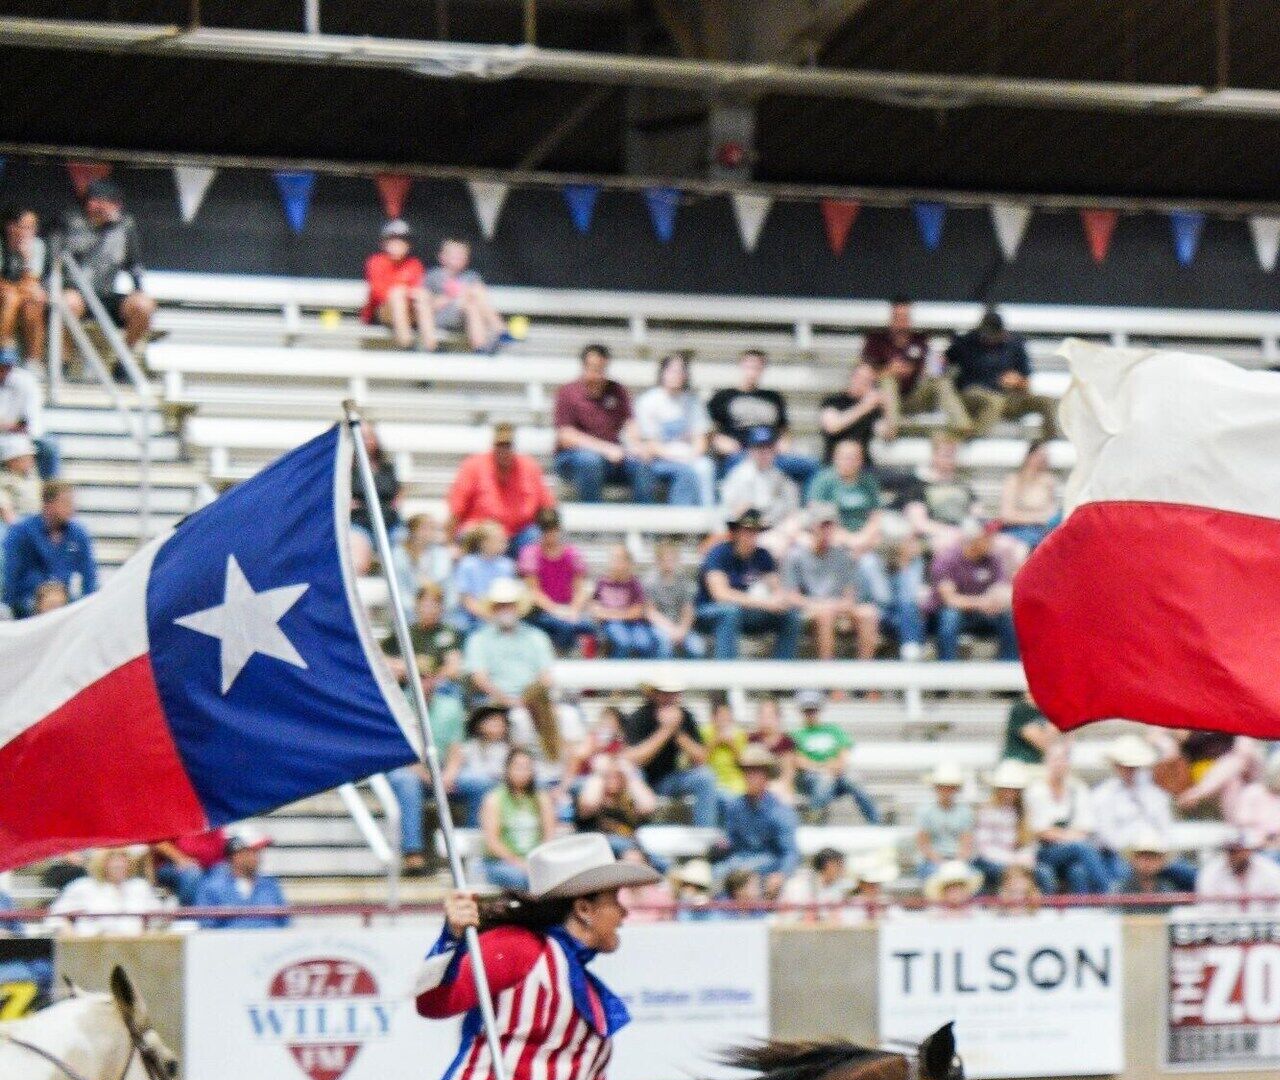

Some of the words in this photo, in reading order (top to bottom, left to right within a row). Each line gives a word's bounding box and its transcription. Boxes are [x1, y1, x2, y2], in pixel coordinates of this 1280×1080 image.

[284, 963, 361, 998] 97.7
[891, 947, 1111, 994] TILSON
[247, 1003, 395, 1038] WILLY
